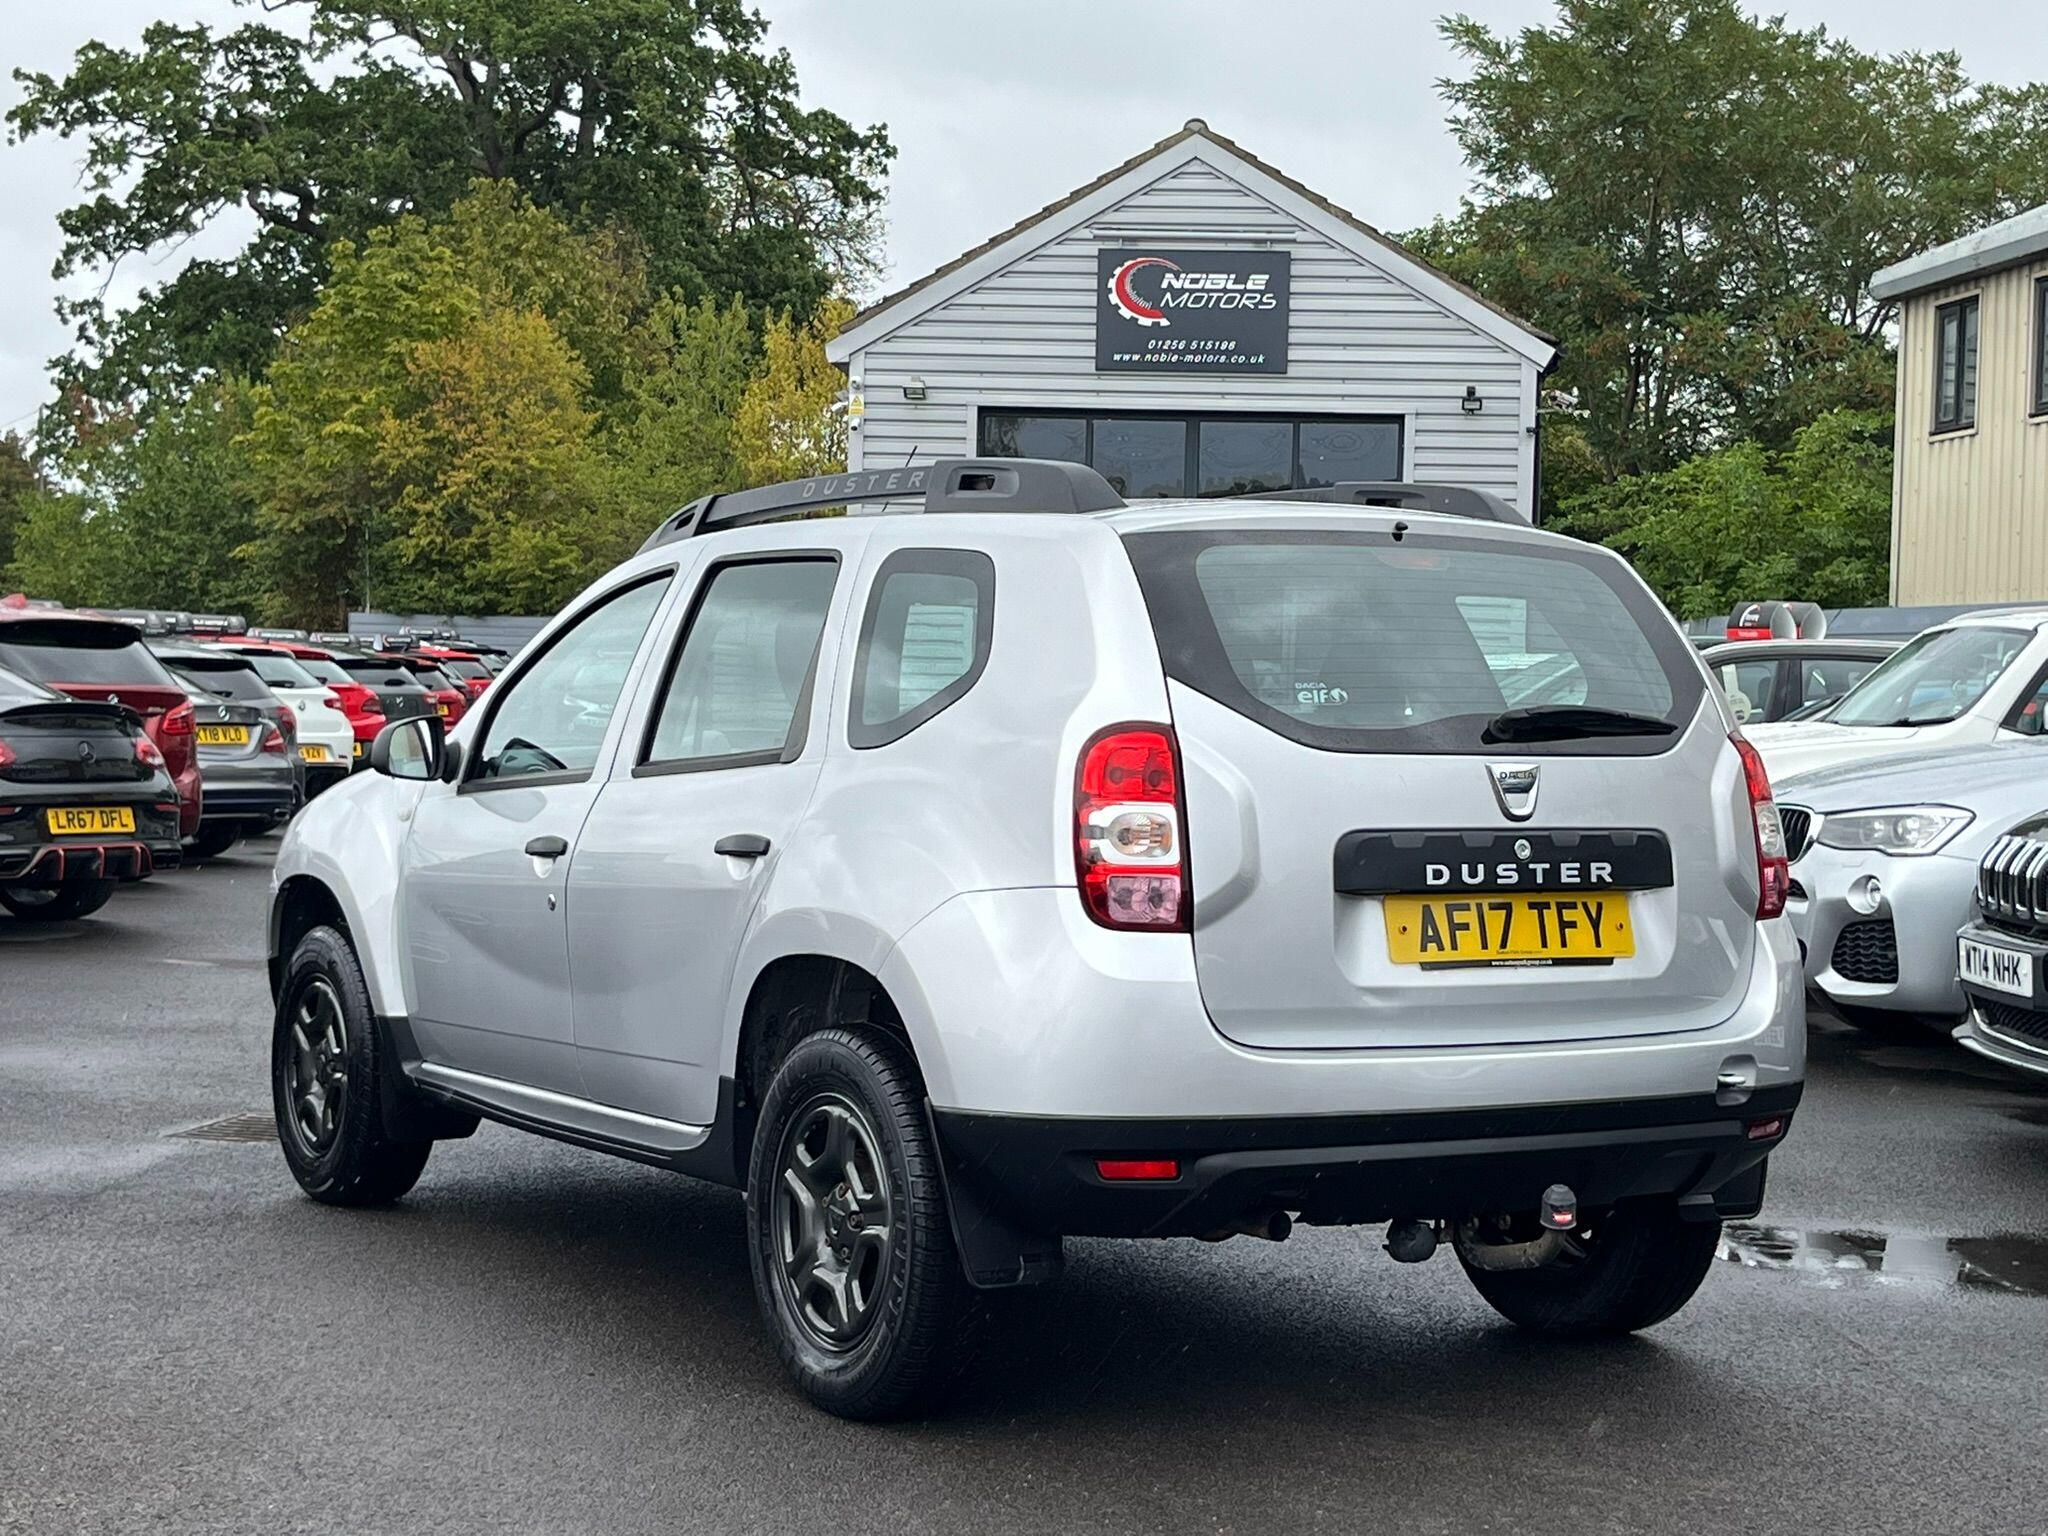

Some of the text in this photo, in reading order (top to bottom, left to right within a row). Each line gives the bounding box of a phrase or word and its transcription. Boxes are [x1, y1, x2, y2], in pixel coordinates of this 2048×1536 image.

[1161, 273, 1270, 290] NOBLE
[1160, 292, 1277, 309] MOTORS
[1148, 340, 1186, 350] 01256
[1113, 352, 1265, 364] www.noble-motors.co.uk
[802, 471, 924, 497] DUSTER
[1297, 689, 1329, 703] elf
[54, 809, 129, 829] LR67 DFL
[1426, 862, 1613, 886] DUSTER
[1420, 901, 1603, 952] AF17 TFY
[1993, 950, 2021, 987] NHK
